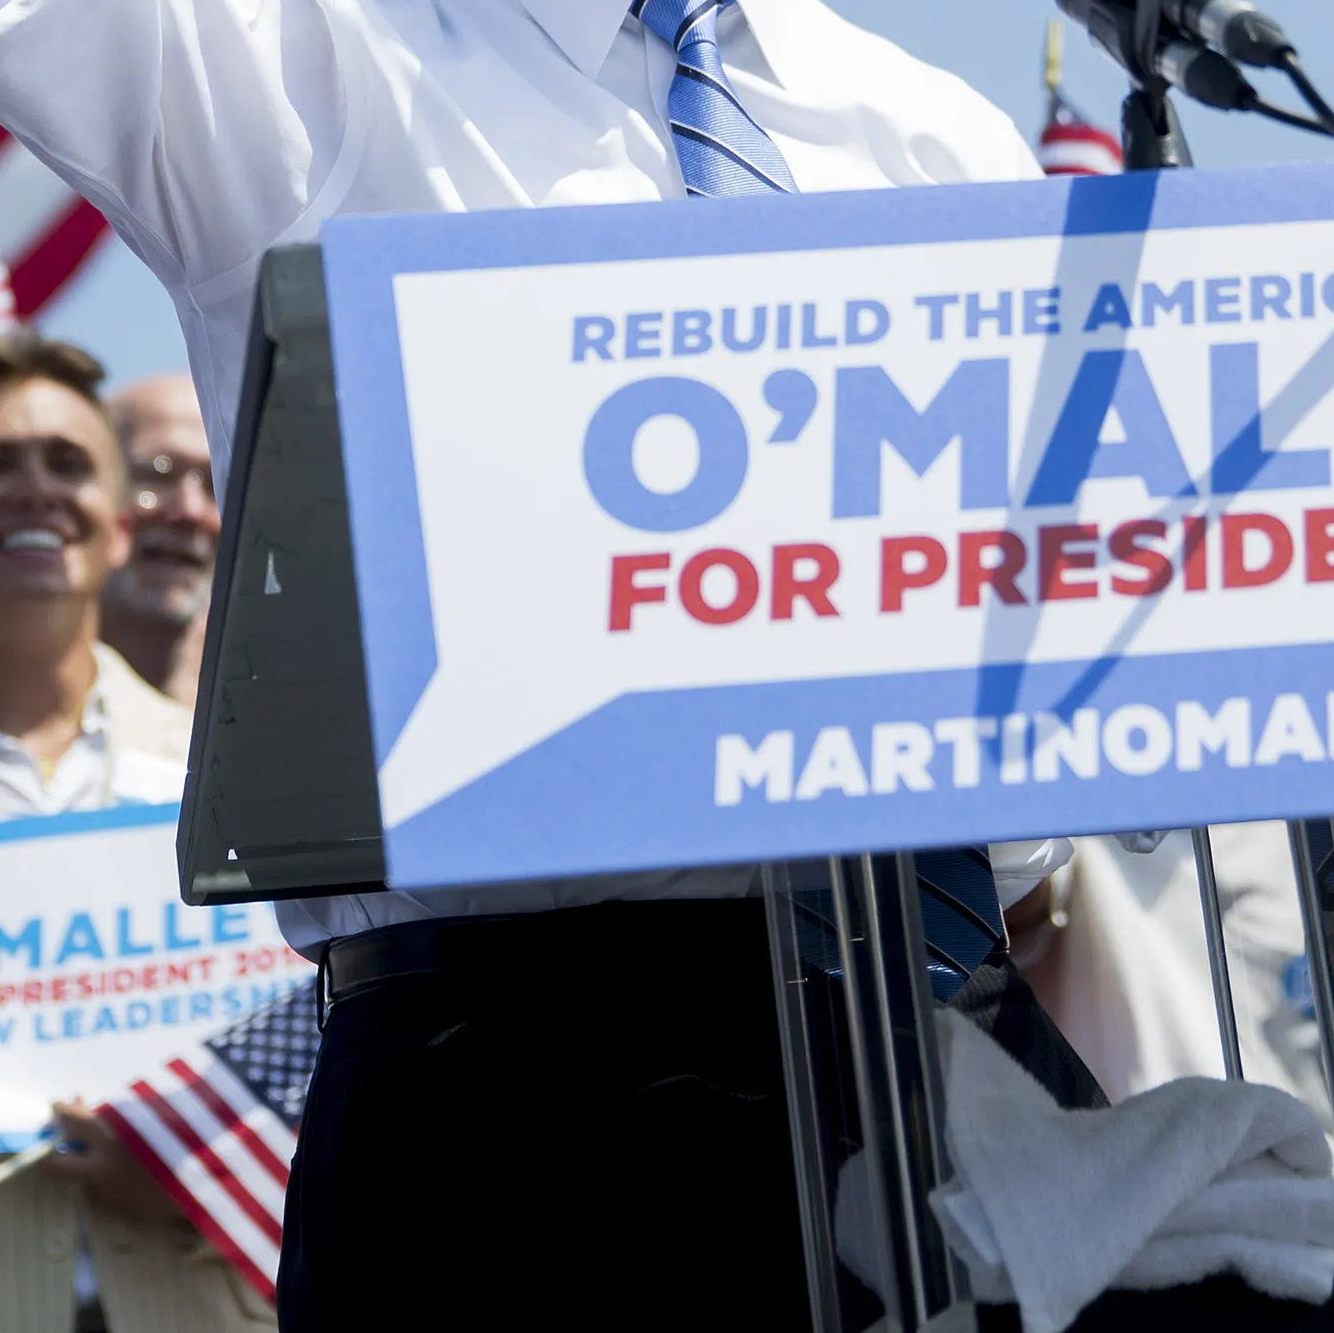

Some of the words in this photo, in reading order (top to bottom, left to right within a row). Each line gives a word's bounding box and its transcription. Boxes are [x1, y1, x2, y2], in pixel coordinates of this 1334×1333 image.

[570, 299, 892, 363] REBUILD
[913, 287, 1063, 343] THE
[606, 547, 842, 633] FOR
[234, 943, 311, 978] 201
